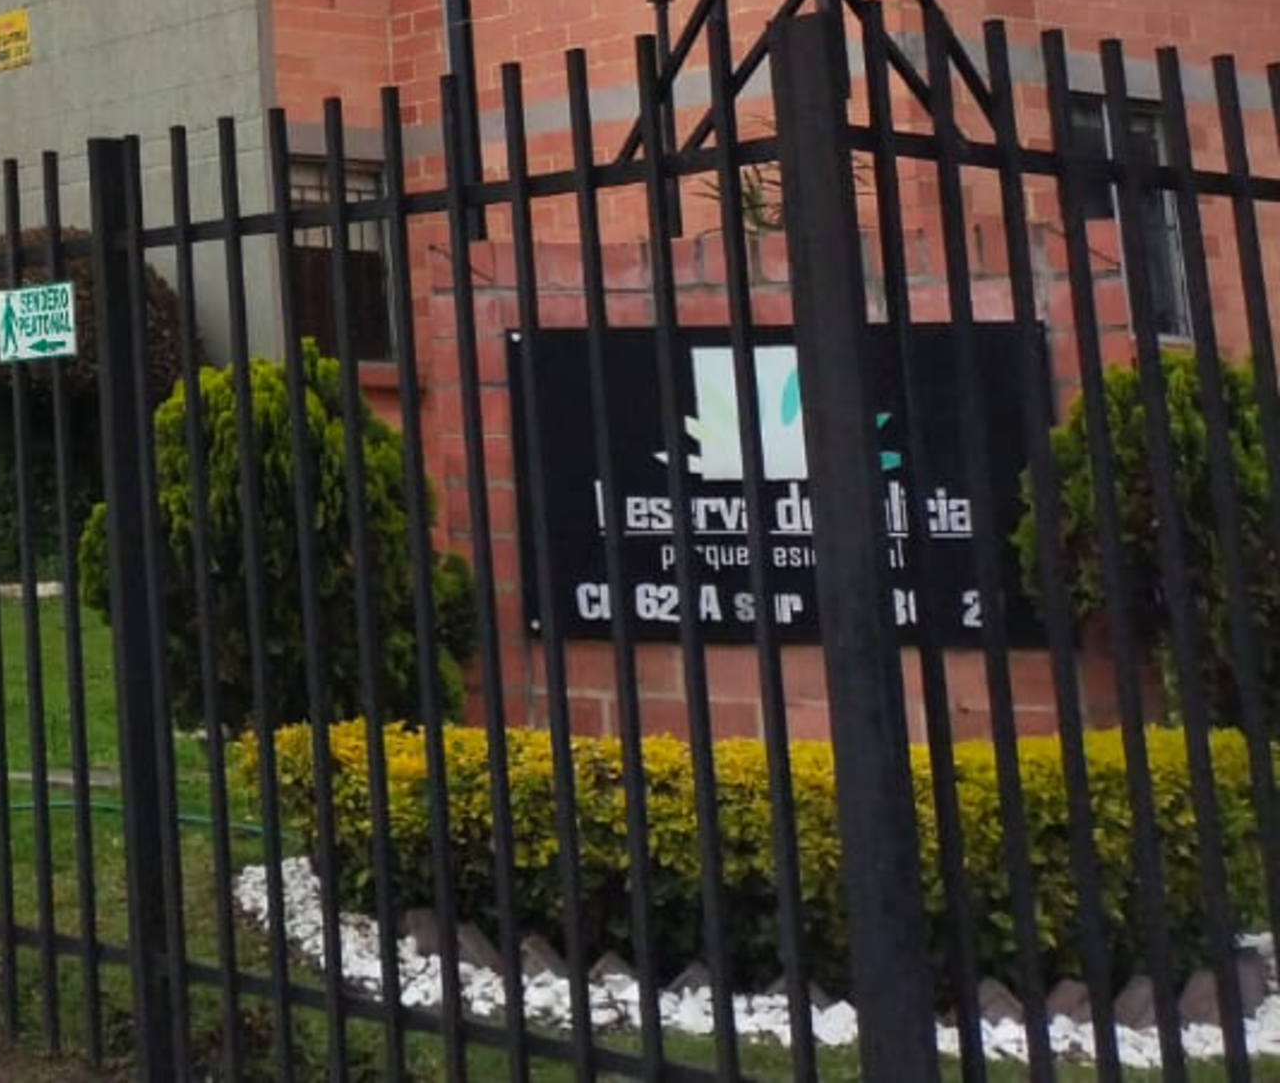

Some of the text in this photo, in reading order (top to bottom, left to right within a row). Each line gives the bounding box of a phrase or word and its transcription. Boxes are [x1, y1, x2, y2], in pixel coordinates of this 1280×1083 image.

[20, 287, 69, 314] SENDERO
[19, 311, 72, 337] PEATONAL
[594, 480, 749, 530] esrv
[635, 582, 681, 623] 62
[699, 584, 723, 622] A
